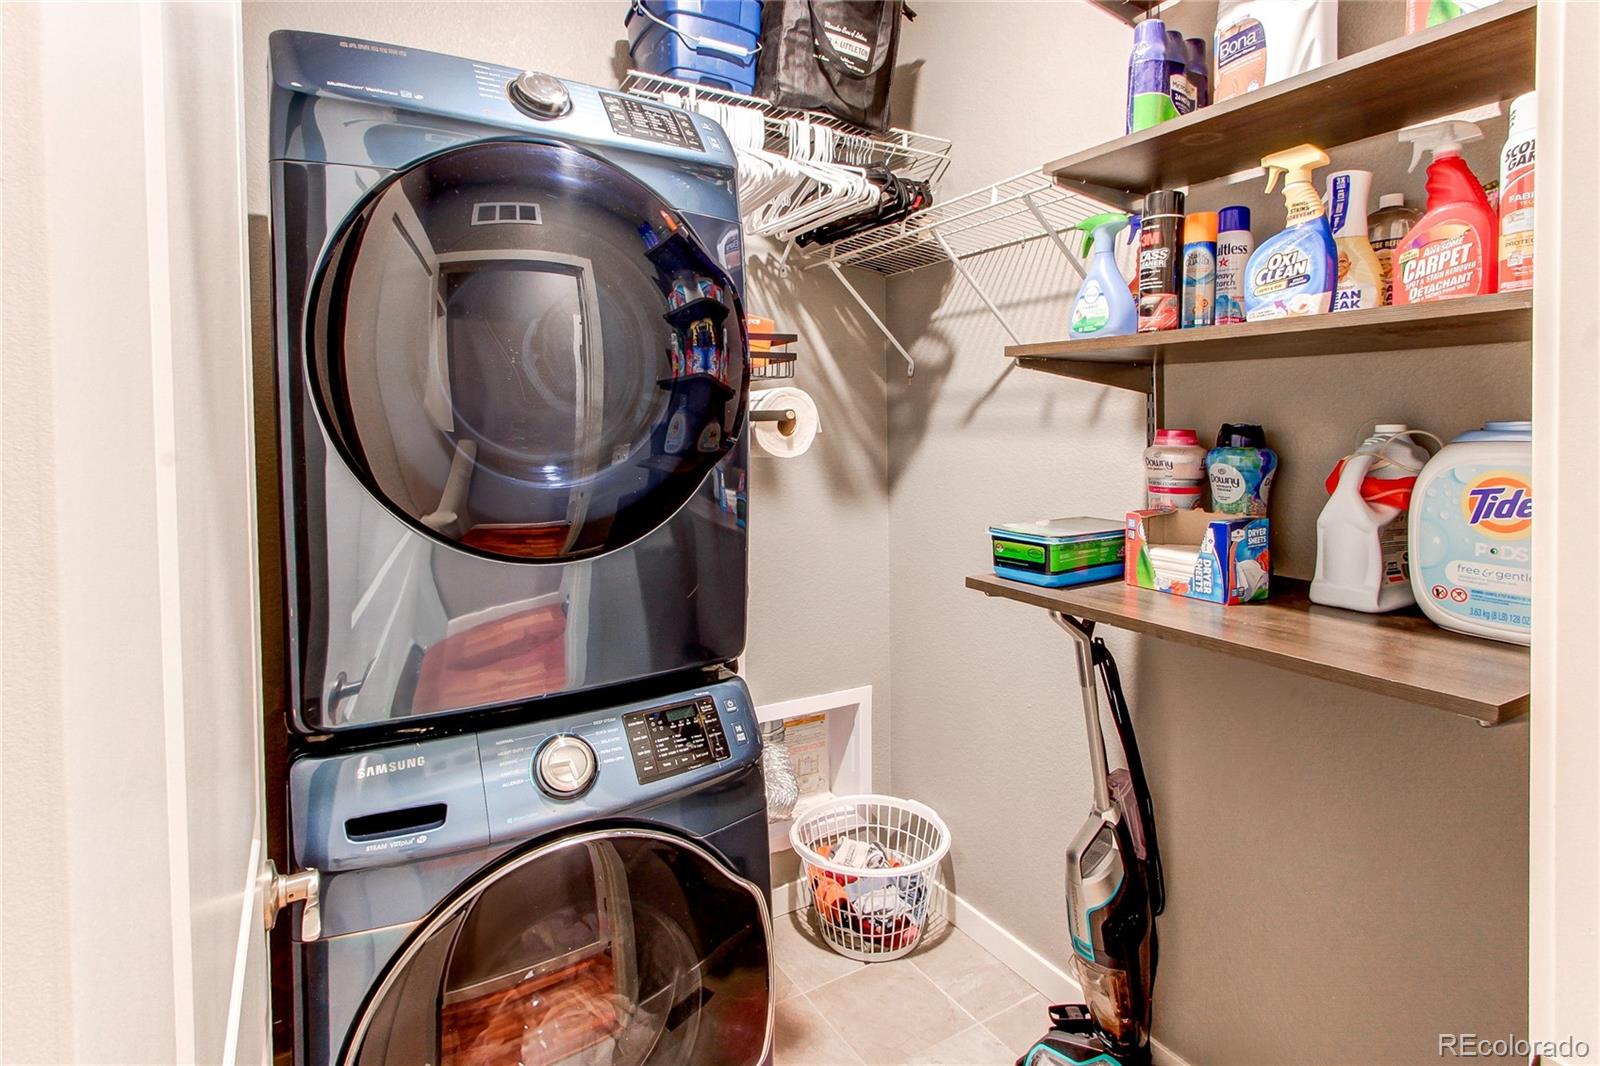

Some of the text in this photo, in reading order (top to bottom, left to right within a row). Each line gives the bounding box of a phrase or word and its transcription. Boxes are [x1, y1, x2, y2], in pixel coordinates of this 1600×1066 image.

[840, 40, 868, 56] LITTLETON
[1218, 31, 1257, 60] Bona
[1141, 231, 1161, 247] 3M
[1268, 250, 1299, 271] OXI
[1403, 242, 1473, 285] CARPET
[1445, 260, 1477, 277] REMOVER
[1216, 272, 1235, 280] eavy
[1255, 258, 1308, 287] CLEAN
[1216, 279, 1236, 288] tarch
[1144, 456, 1173, 470] Downy
[1210, 473, 1240, 488] Downy
[1469, 487, 1532, 525] Tide
[1247, 527, 1267, 538] DRYER
[1247, 536, 1267, 546] SHEETS
[1202, 559, 1213, 594] DRYER
[1457, 564, 1480, 575] free
[1470, 606, 1482, 617] 3.63
[1483, 608, 1490, 620] kg
[1510, 614, 1521, 624] 128
[357, 756, 426, 779] SAMSUNG
